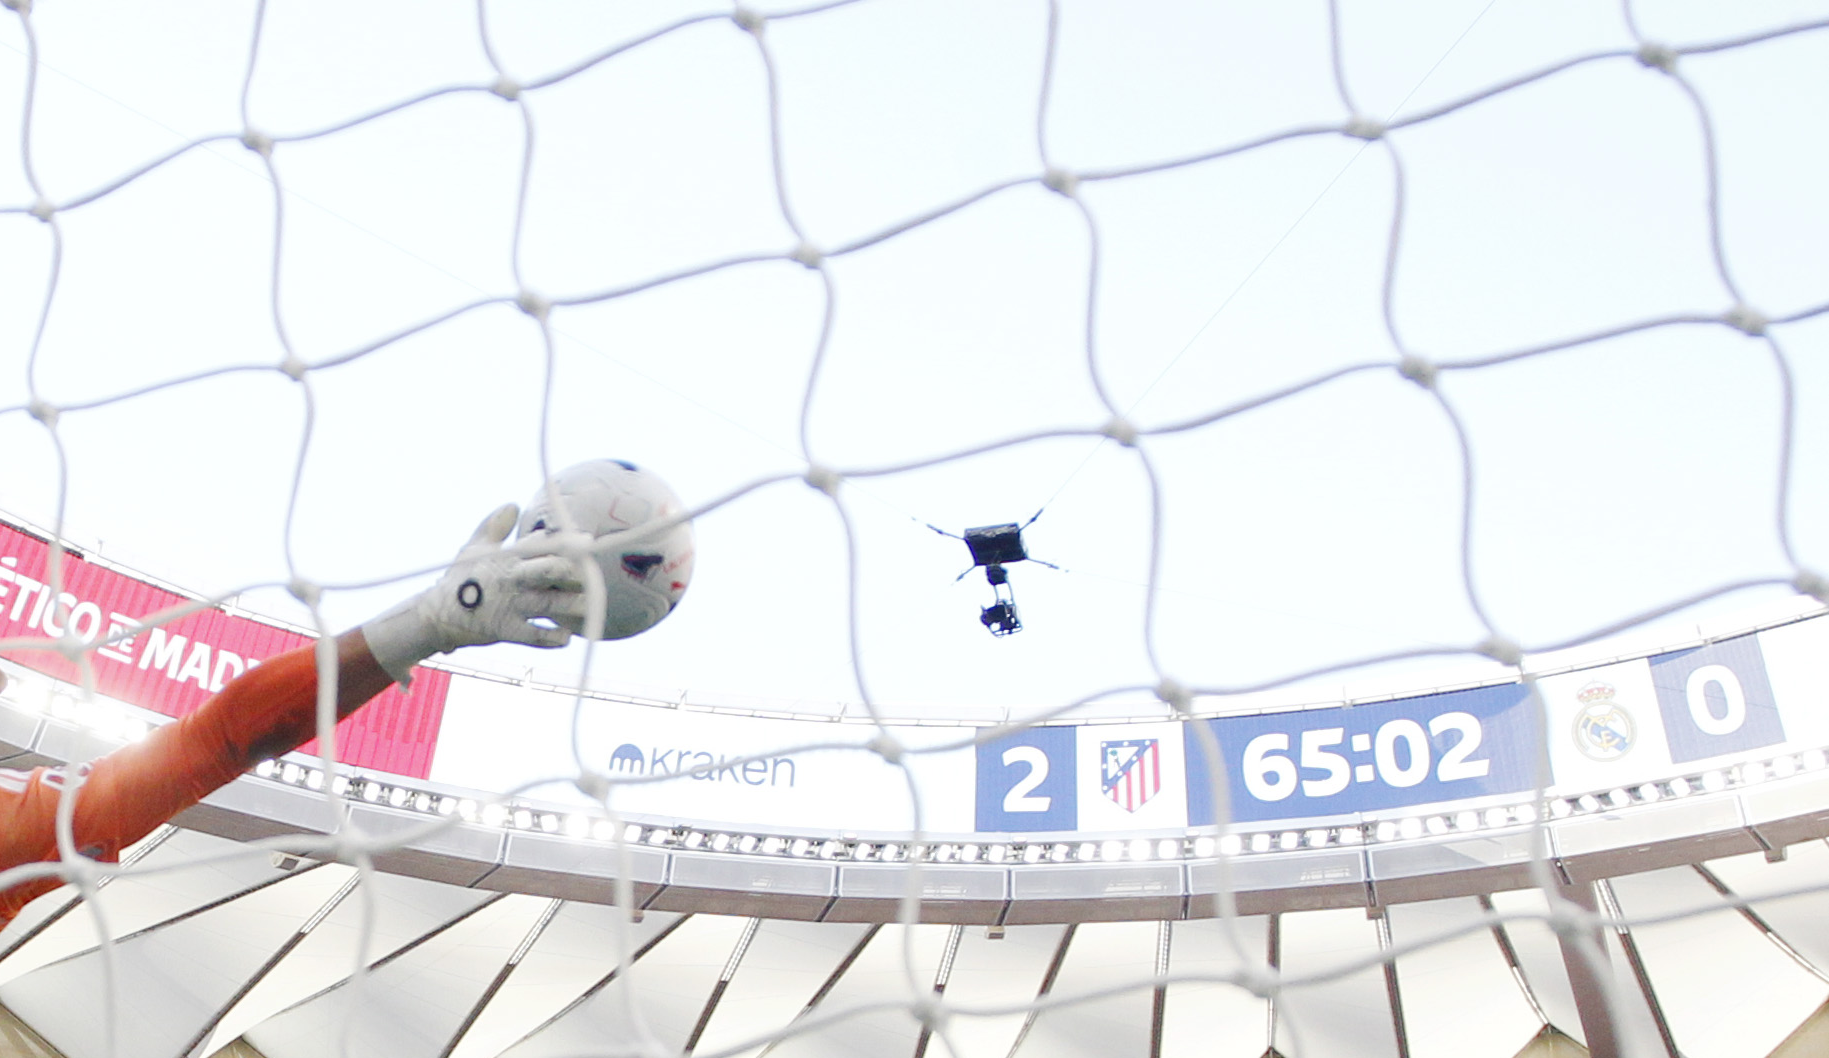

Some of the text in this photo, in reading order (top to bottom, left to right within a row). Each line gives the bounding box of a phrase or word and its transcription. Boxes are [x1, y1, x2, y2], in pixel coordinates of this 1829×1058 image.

[139, 627, 262, 694] MAD
[1685, 663, 1748, 736] 0
[649, 747, 796, 787] kraken
[1000, 745, 1052, 813] 2
[1242, 711, 1491, 802] 65:02
